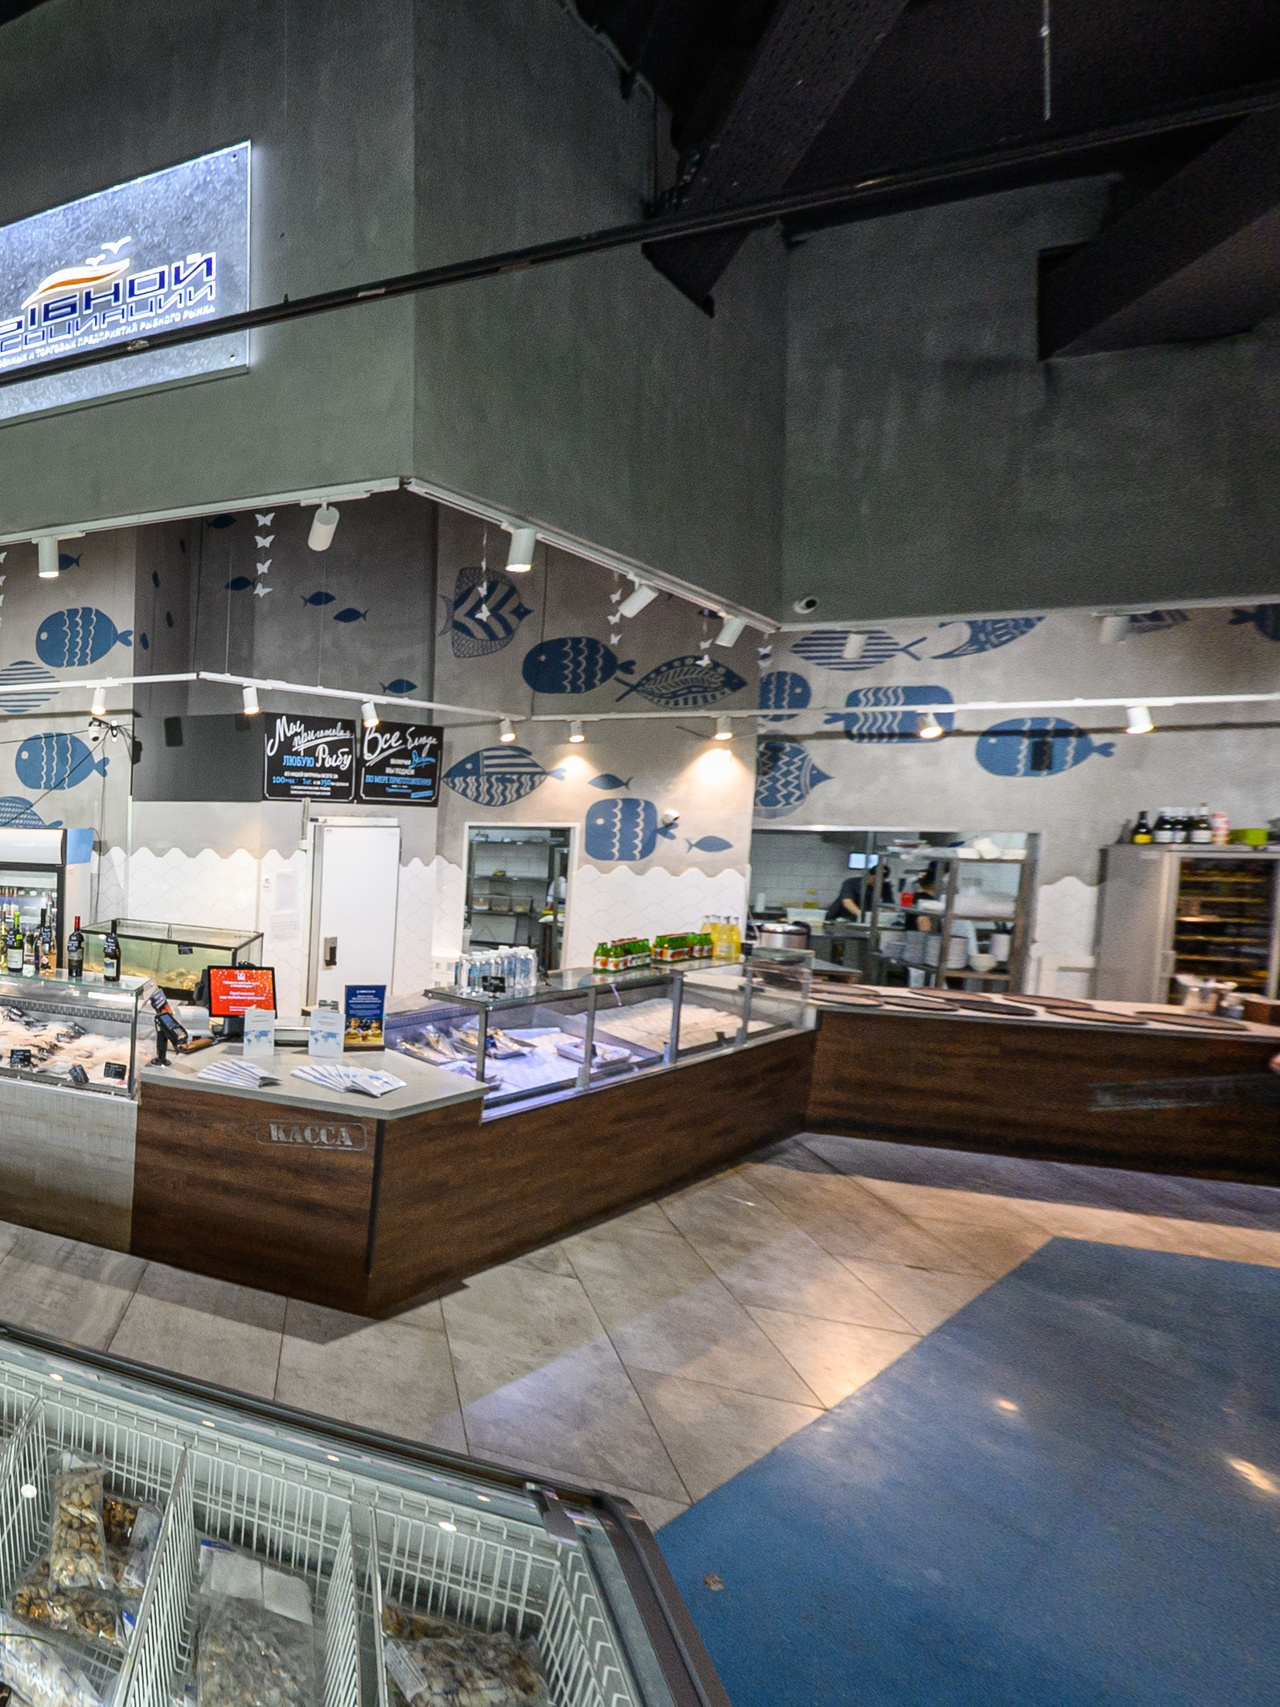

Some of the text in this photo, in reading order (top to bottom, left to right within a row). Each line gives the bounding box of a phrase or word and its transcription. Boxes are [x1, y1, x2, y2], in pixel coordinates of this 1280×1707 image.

[78, 321, 138, 347] ПРЕДПРИЯТИЙ
[139, 312, 181, 331] РЫБНОГО
[183, 304, 216, 321] РЫНКА
[283, 744, 352, 771] ЛЮБУЮ Рыбу
[363, 727, 403, 760] Все
[269, 1123, 353, 1146] КАССА
